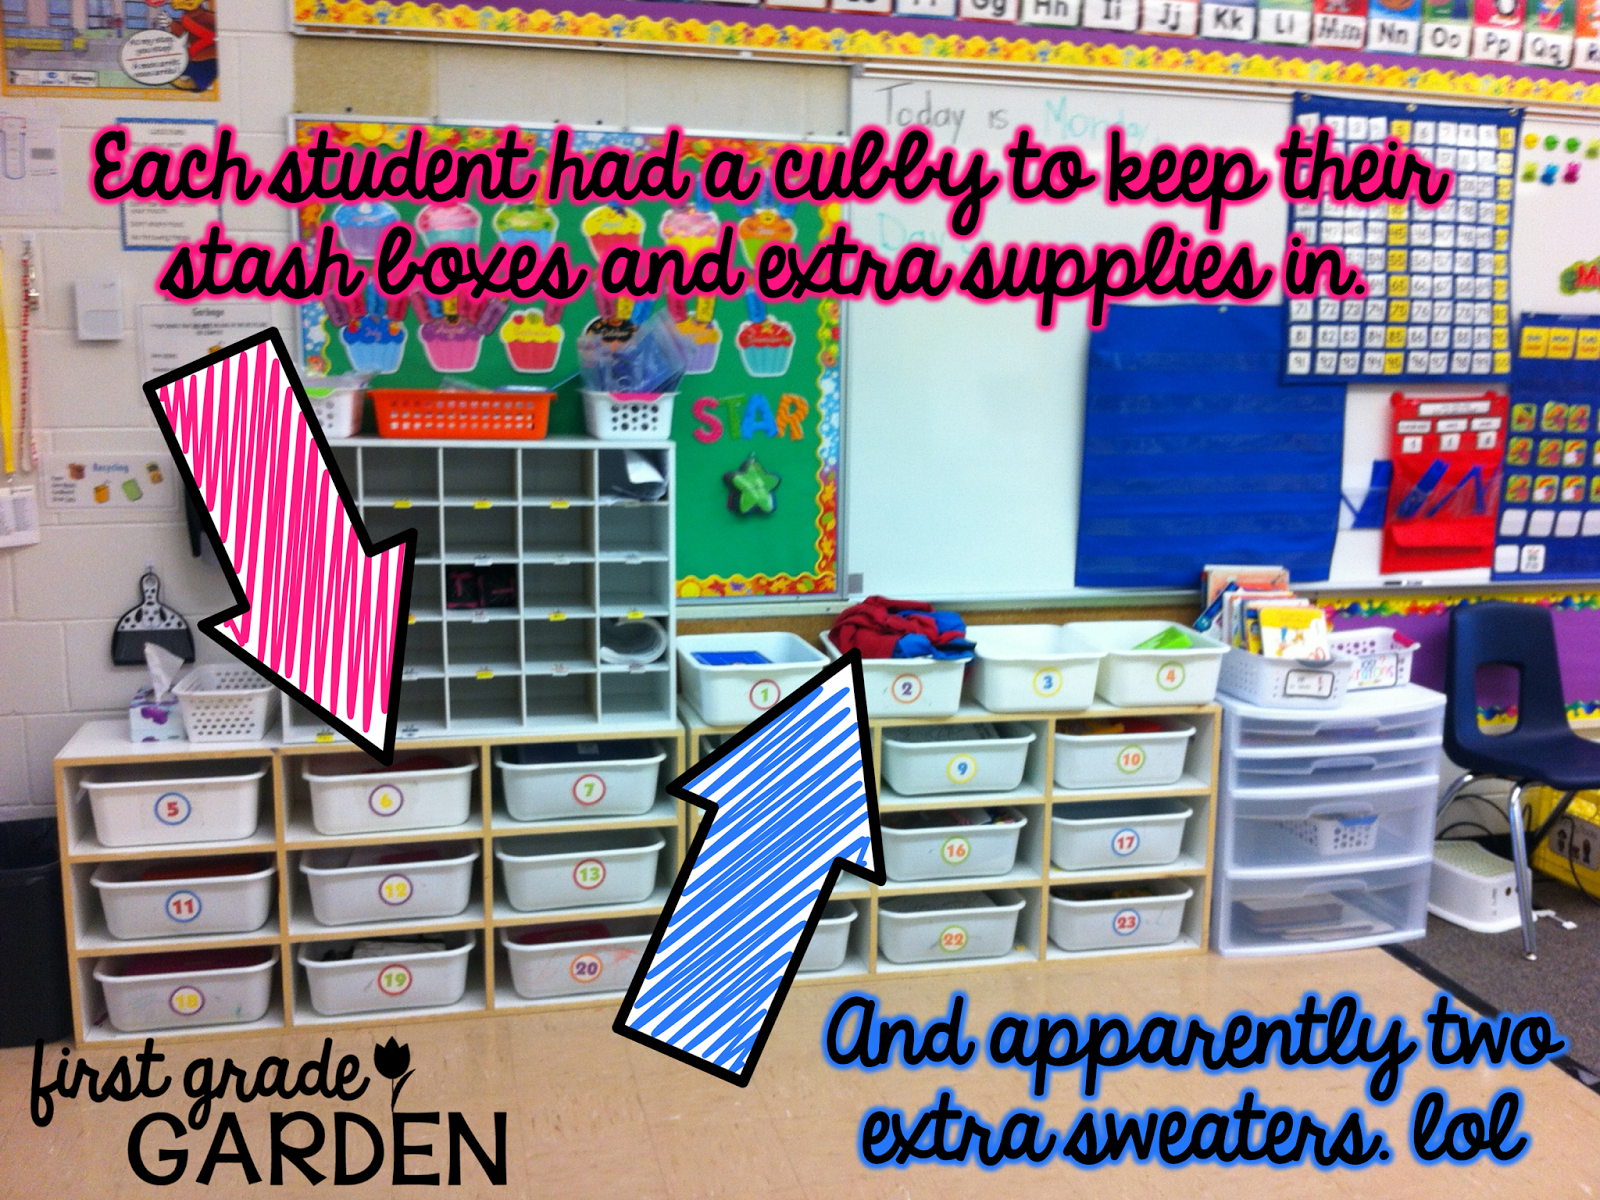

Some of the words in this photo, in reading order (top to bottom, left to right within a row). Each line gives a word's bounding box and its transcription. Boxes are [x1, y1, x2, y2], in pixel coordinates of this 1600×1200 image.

[1158, 4, 1182, 31] Jj
[1213, 7, 1243, 31] Kk
[1378, 23, 1409, 45] Nn
[1429, 27, 1462, 50] Oo
[1482, 31, 1511, 55] Pp
[1531, 37, 1564, 65] Qq
[875, 82, 965, 144] Today
[988, 107, 1010, 130] is
[692, 393, 809, 444] STAR
[1042, 675, 1054, 689] 3
[1164, 669, 1177, 683] 4
[759, 688, 770, 701] 1
[900, 682, 913, 696] 2
[1121, 752, 1142, 766] 10
[957, 761, 968, 776] 9
[583, 781, 596, 797] 7
[379, 792, 393, 808] 6
[166, 801, 179, 817] 5
[1116, 835, 1135, 849] 17
[946, 843, 966, 858] 16
[579, 866, 601, 882] 13
[384, 882, 407, 898] 12
[172, 899, 195, 914] 11
[1116, 914, 1137, 929] 23
[942, 932, 964, 947] 22
[575, 961, 599, 976] 20
[383, 971, 406, 988] 19
[174, 993, 199, 1009] 18
